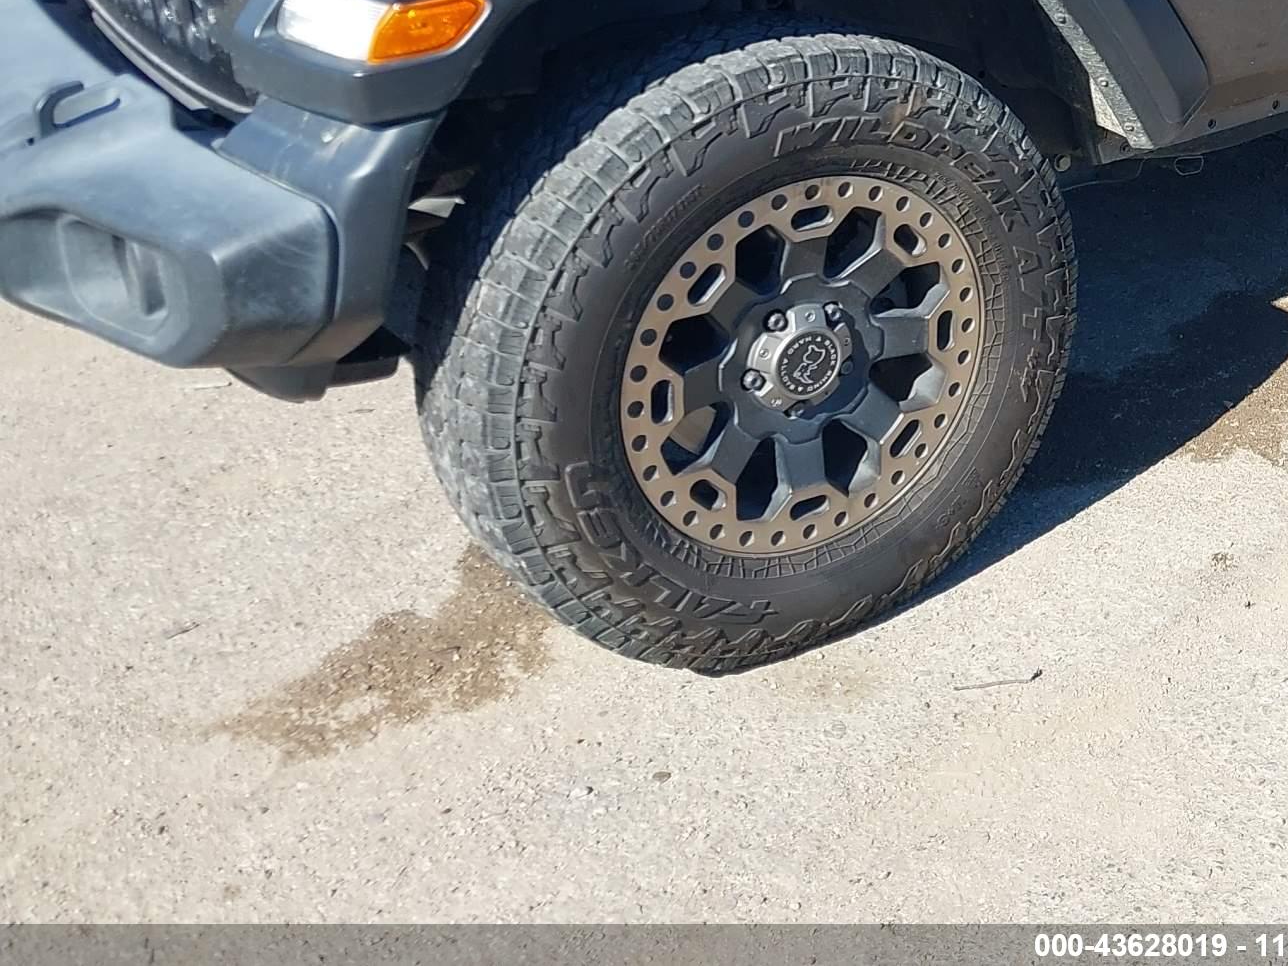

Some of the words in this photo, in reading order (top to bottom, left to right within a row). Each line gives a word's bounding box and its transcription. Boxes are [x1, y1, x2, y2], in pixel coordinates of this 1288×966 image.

[774, 116, 1032, 232] WILDPEAK
[806, 370, 833, 393] RHINO
[824, 339, 837, 366] BLACK
[565, 461, 779, 625] FALKEN
